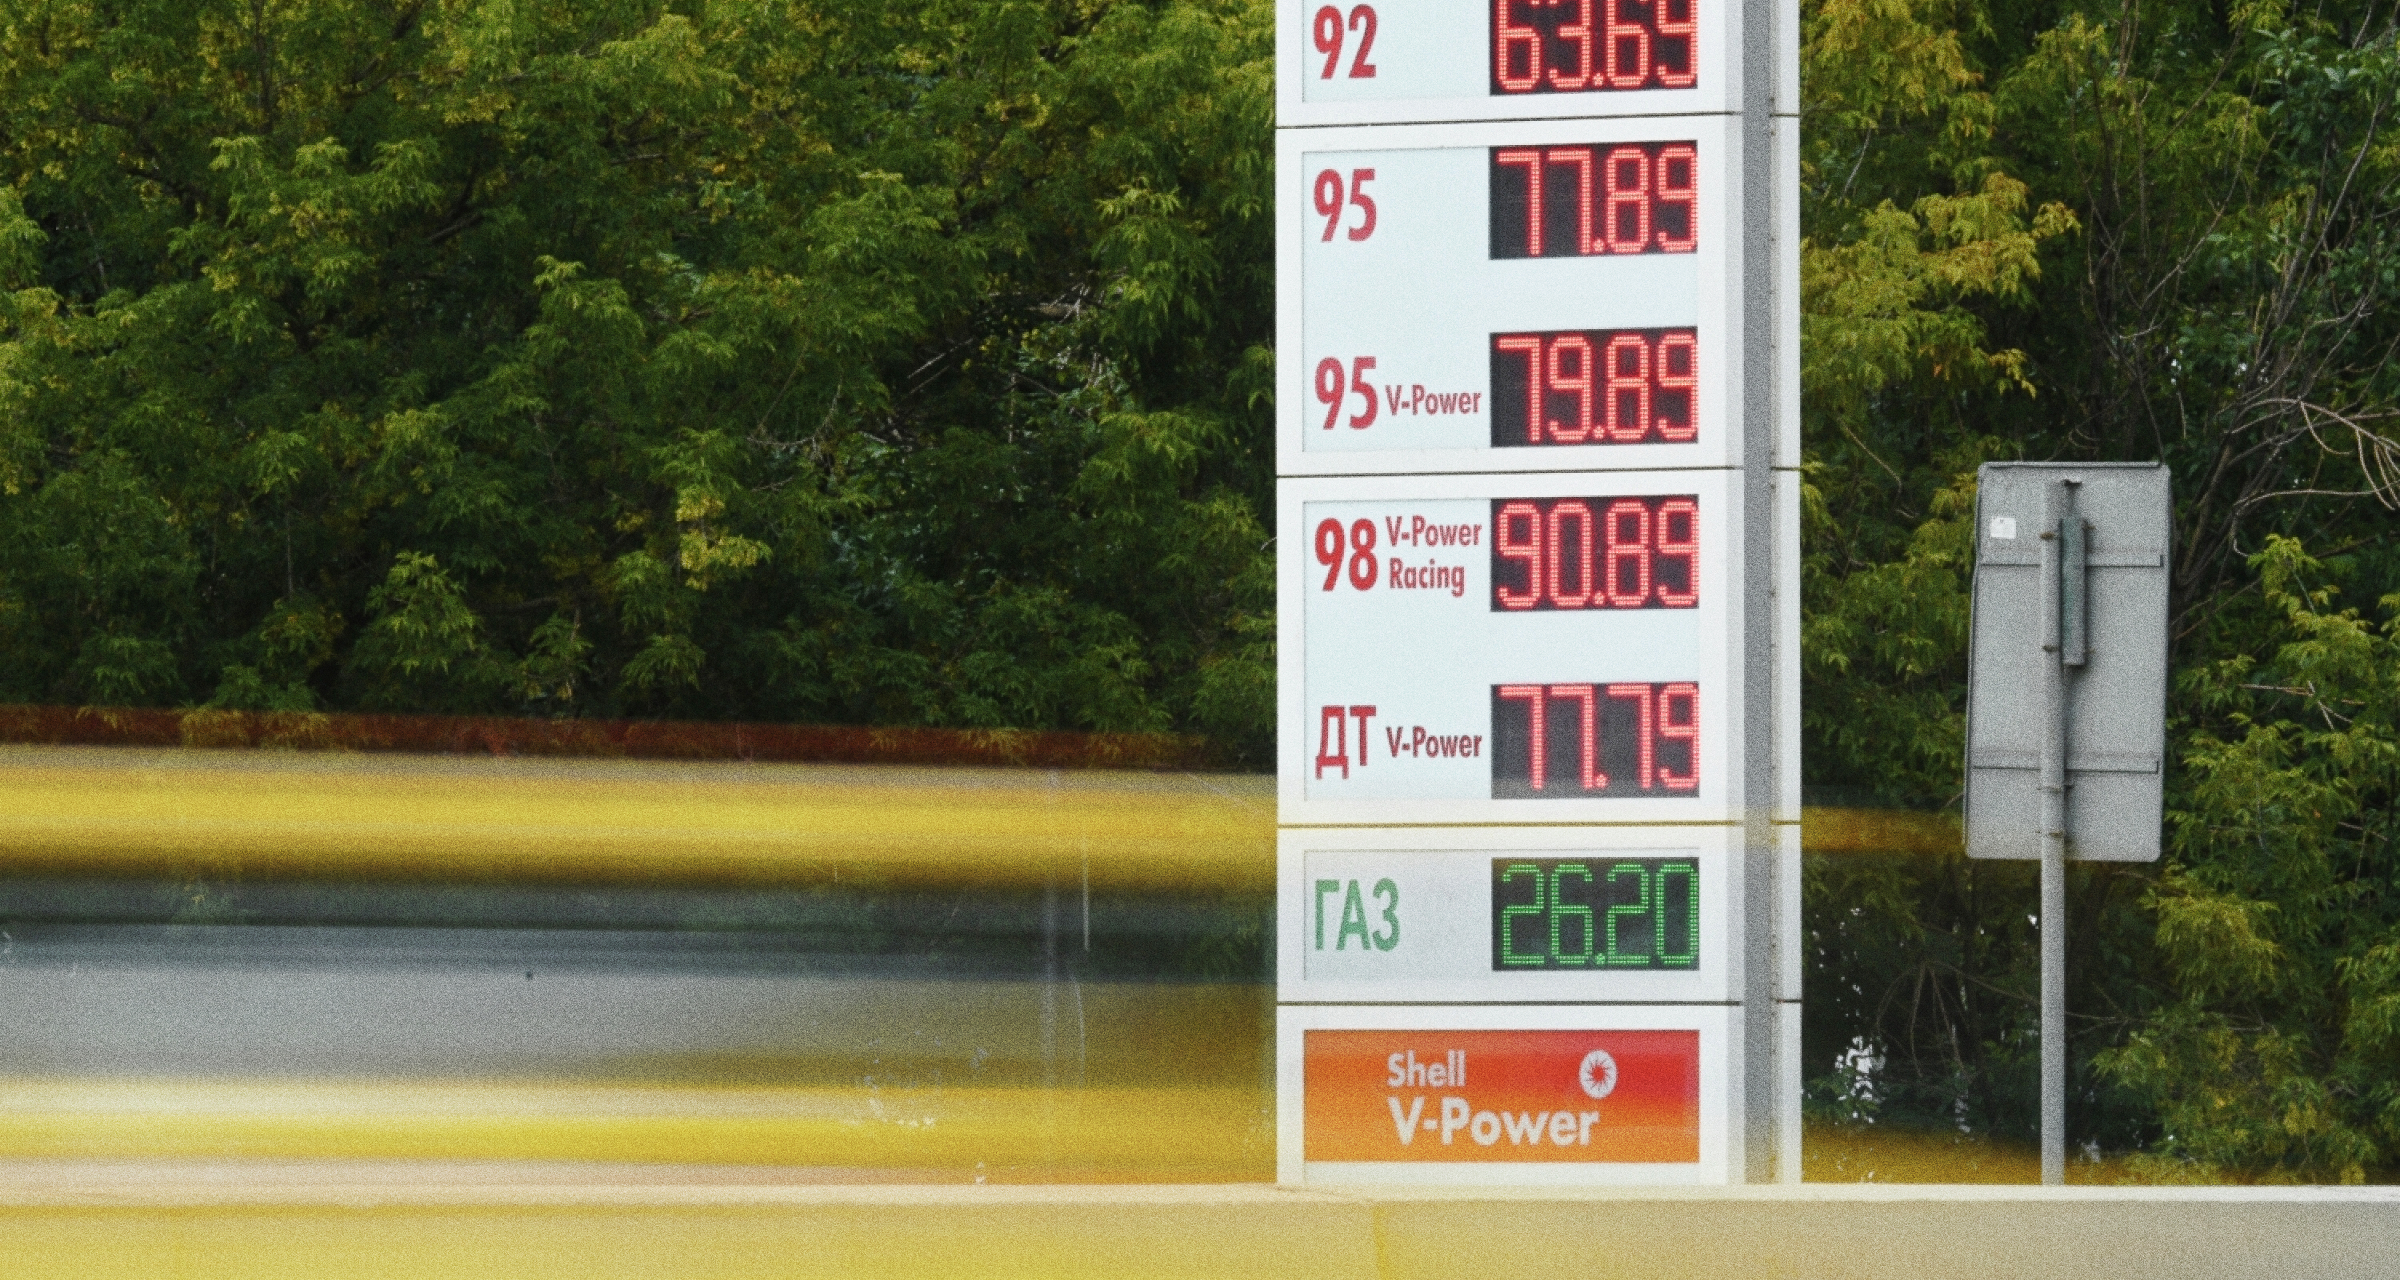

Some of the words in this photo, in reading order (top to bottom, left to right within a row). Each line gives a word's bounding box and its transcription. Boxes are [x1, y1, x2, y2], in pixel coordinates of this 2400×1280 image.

[1313, 4, 1378, 79] 92
[1497, 0, 1698, 90] 63.69
[1314, 168, 1377, 242] 95
[1497, 147, 1698, 256] 77.89
[1314, 357, 1379, 430] 95
[1385, 384, 1481, 416] V-Power
[1497, 334, 1699, 443] 79.89
[1314, 518, 1379, 592] 98
[1386, 515, 1482, 546] V-Power
[1389, 558, 1465, 597] Racing
[1497, 500, 1699, 608] 90.89
[1315, 705, 1377, 779] ДТ
[1386, 727, 1482, 759] V-Power
[1500, 682, 1699, 790] 77.79
[1314, 878, 1400, 952] ГАЗ
[1502, 863, 1699, 966] 26.20
[1387, 1050, 1466, 1088] Shell
[1387, 1096, 1600, 1147] V-Power
